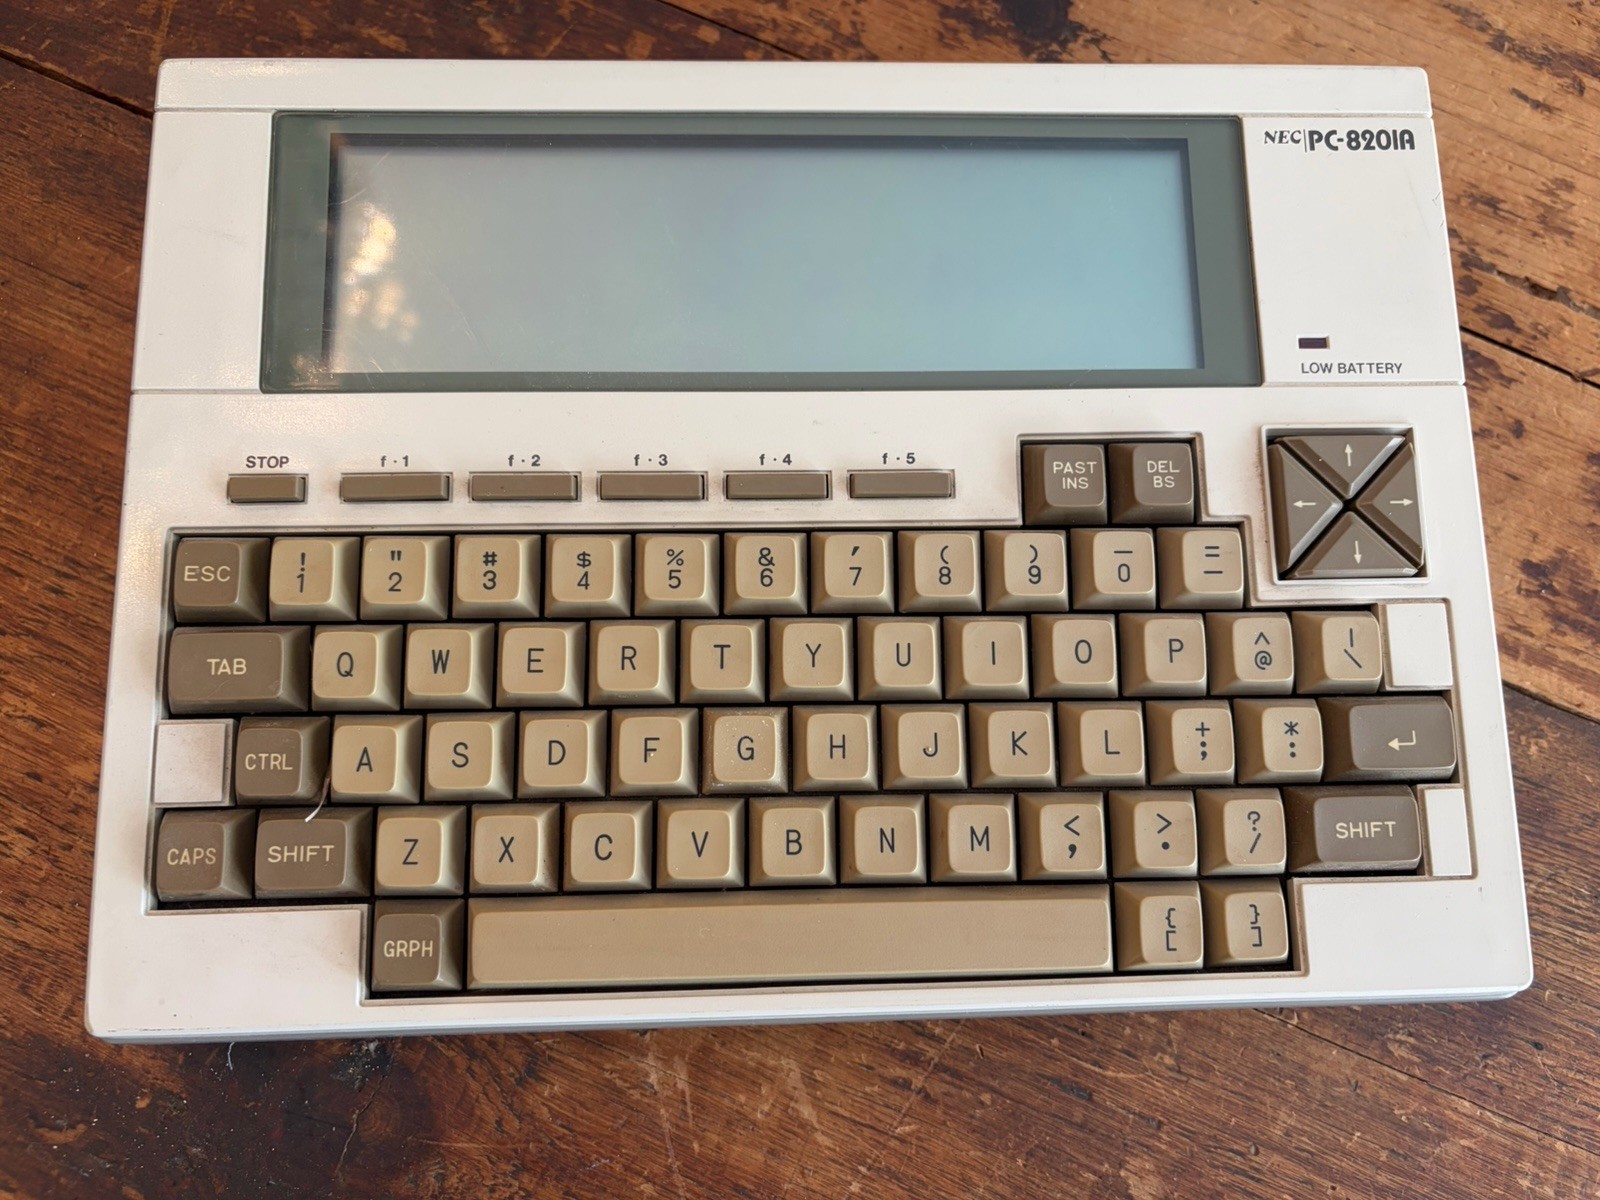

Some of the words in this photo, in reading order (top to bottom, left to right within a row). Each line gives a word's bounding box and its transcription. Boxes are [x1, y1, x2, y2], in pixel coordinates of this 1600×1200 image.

[1264, 129, 1302, 145] NEC
[1308, 129, 1415, 151] PC-8201A
[1300, 361, 1334, 374] LOW
[1337, 362, 1403, 374] BATTERY
[245, 455, 290, 469] STOP
[1052, 461, 1097, 474] PAST
[1146, 460, 1180, 473] DEL
[1062, 476, 1089, 490] INS
[1153, 475, 1175, 488] BS
[299, 552, 306, 573] !
[482, 551, 498, 567] #
[576, 550, 592, 569] $
[666, 548, 685, 567] %
[757, 546, 776, 567] &
[940, 545, 949, 565] (
[1029, 544, 1039, 564] )
[1204, 545, 1221, 558] =
[183, 565, 231, 582] ESC
[296, 572, 305, 594] 1
[387, 571, 403, 593] 2
[482, 569, 497, 591] 3
[576, 570, 590, 591] 4
[668, 569, 682, 590] 5
[760, 567, 774, 588] 6
[848, 566, 863, 586] 7
[938, 565, 952, 586] 8
[1027, 564, 1042, 585] 9
[1117, 563, 1131, 583] 0
[1254, 631, 1271, 646] ^
[431, 649, 451, 675] W
[526, 647, 545, 674] E
[621, 645, 637, 671] R
[713, 644, 732, 670] T
[805, 643, 822, 668] Y
[895, 642, 912, 668] U
[991, 640, 996, 666] I
[1074, 639, 1093, 665] O
[1168, 638, 1184, 664] P
[1254, 650, 1273, 671] @
[1343, 648, 1363, 669] \
[206, 657, 247, 676] TAB
[336, 651, 354, 678] Q
[1194, 721, 1211, 738] +
[547, 739, 567, 766] D
[643, 737, 661, 764] F
[737, 735, 755, 761] G
[829, 734, 846, 760] H
[922, 732, 939, 758] J
[1011, 730, 1028, 756] K
[1104, 729, 1121, 755] L
[1199, 740, 1208, 761] ;
[1288, 741, 1297, 759] :
[244, 753, 293, 771] CTRL
[355, 746, 374, 773] A
[451, 741, 470, 769] S
[1063, 815, 1081, 837] <
[1156, 813, 1173, 835] >
[1247, 810, 1261, 832] ?
[1335, 820, 1396, 839] SHIFT
[498, 836, 515, 863] X
[594, 833, 613, 861] C
[691, 830, 709, 858] V
[785, 828, 803, 856] B
[879, 827, 895, 854] N
[969, 825, 990, 852] M
[1249, 832, 1262, 854] /
[167, 847, 217, 866] CAPS
[267, 844, 335, 863] SHIFT
[402, 838, 419, 866] Z
[1165, 907, 1177, 929] {
[1248, 903, 1261, 925] }
[1165, 929, 1178, 952] [
[1250, 925, 1263, 948] ]
[383, 939, 434, 958] GRPH
